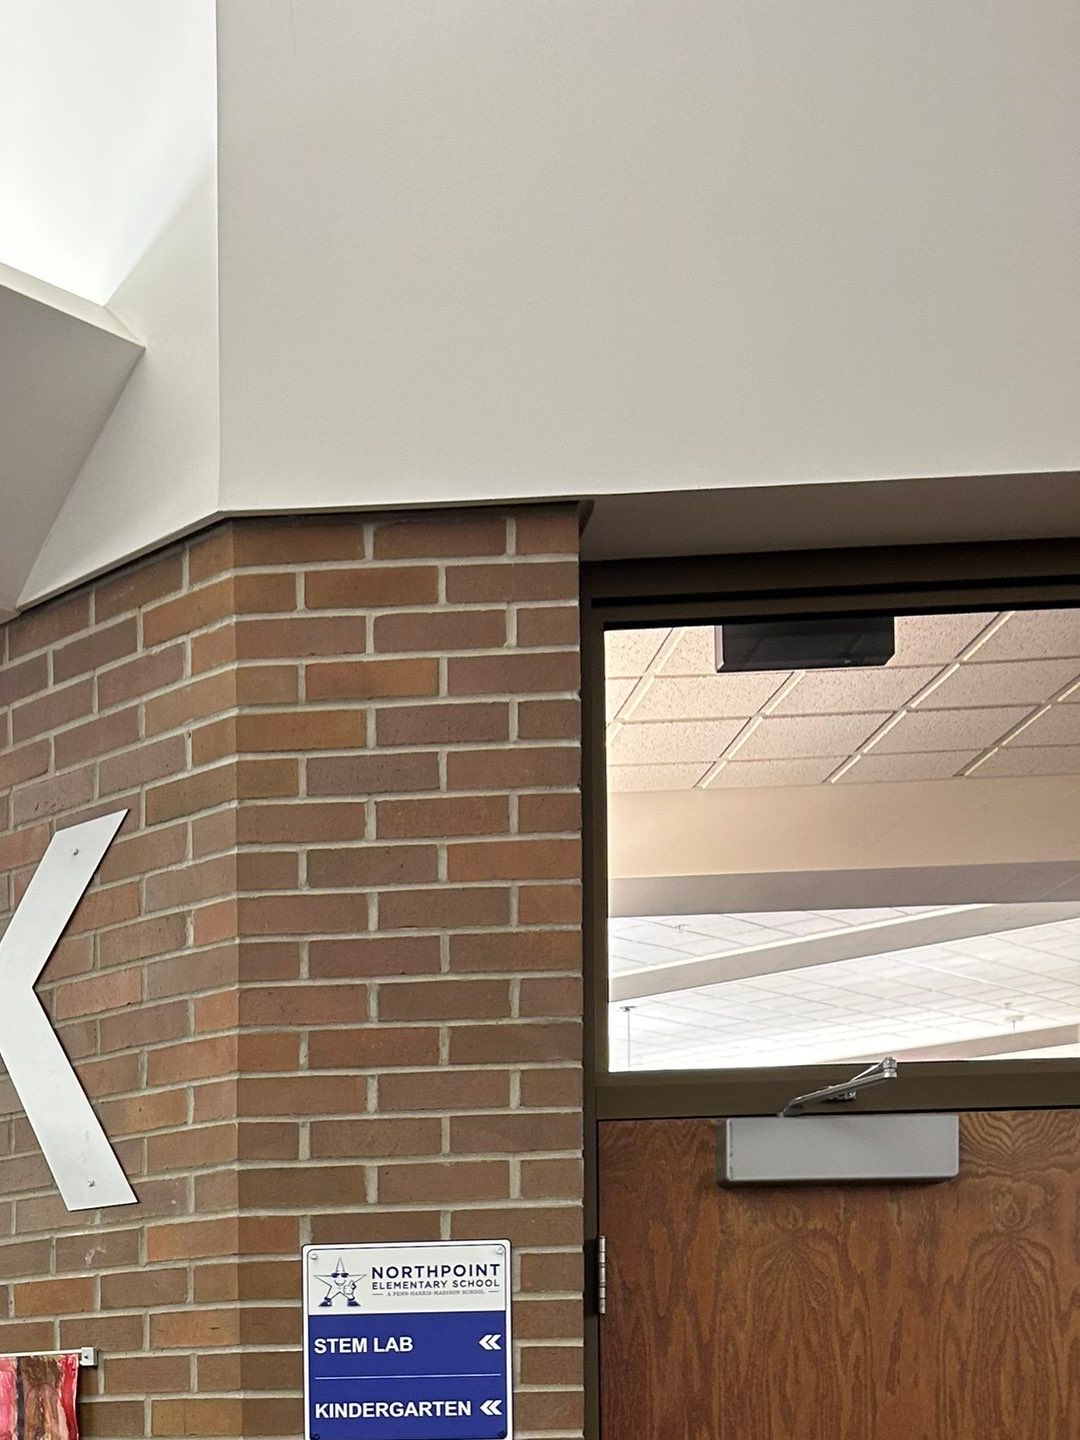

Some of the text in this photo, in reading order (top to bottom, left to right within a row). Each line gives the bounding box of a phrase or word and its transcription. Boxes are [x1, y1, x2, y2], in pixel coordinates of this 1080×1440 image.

[371, 1263, 500, 1279] NORTHPOINT
[371, 1278, 500, 1290] ELEMENTARY SCHOOL
[313, 1336, 414, 1354] STEM LAB
[314, 1400, 472, 1419] KINDERGARTEN
